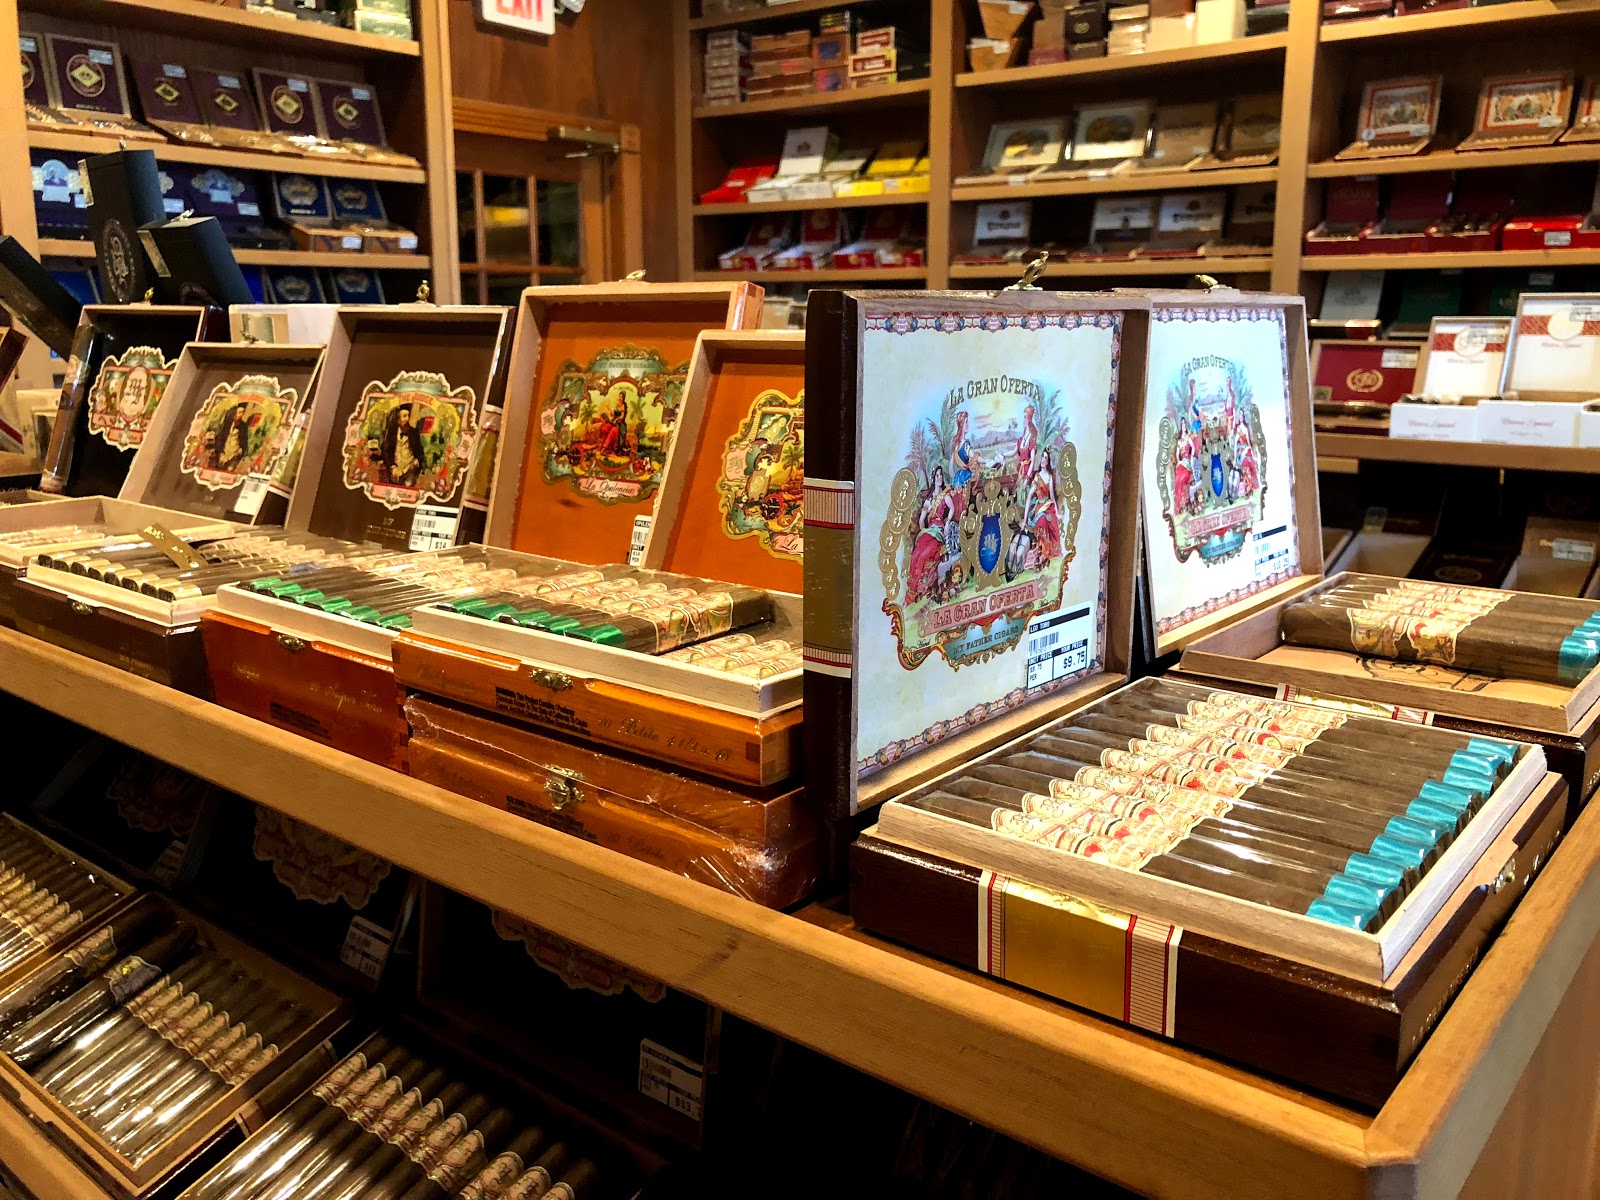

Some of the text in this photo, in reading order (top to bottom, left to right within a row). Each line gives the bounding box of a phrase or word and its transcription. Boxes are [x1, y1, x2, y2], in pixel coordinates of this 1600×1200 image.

[949, 374, 1041, 407] LA GRAN OFERTA
[933, 610, 953, 628] LA
[954, 599, 987, 622] GRAN
[989, 584, 1035, 611] OFERTA
[966, 634, 993, 650] FATHER
[994, 625, 1019, 640] CIGARS
[1063, 650, 1085, 669] $9.75
